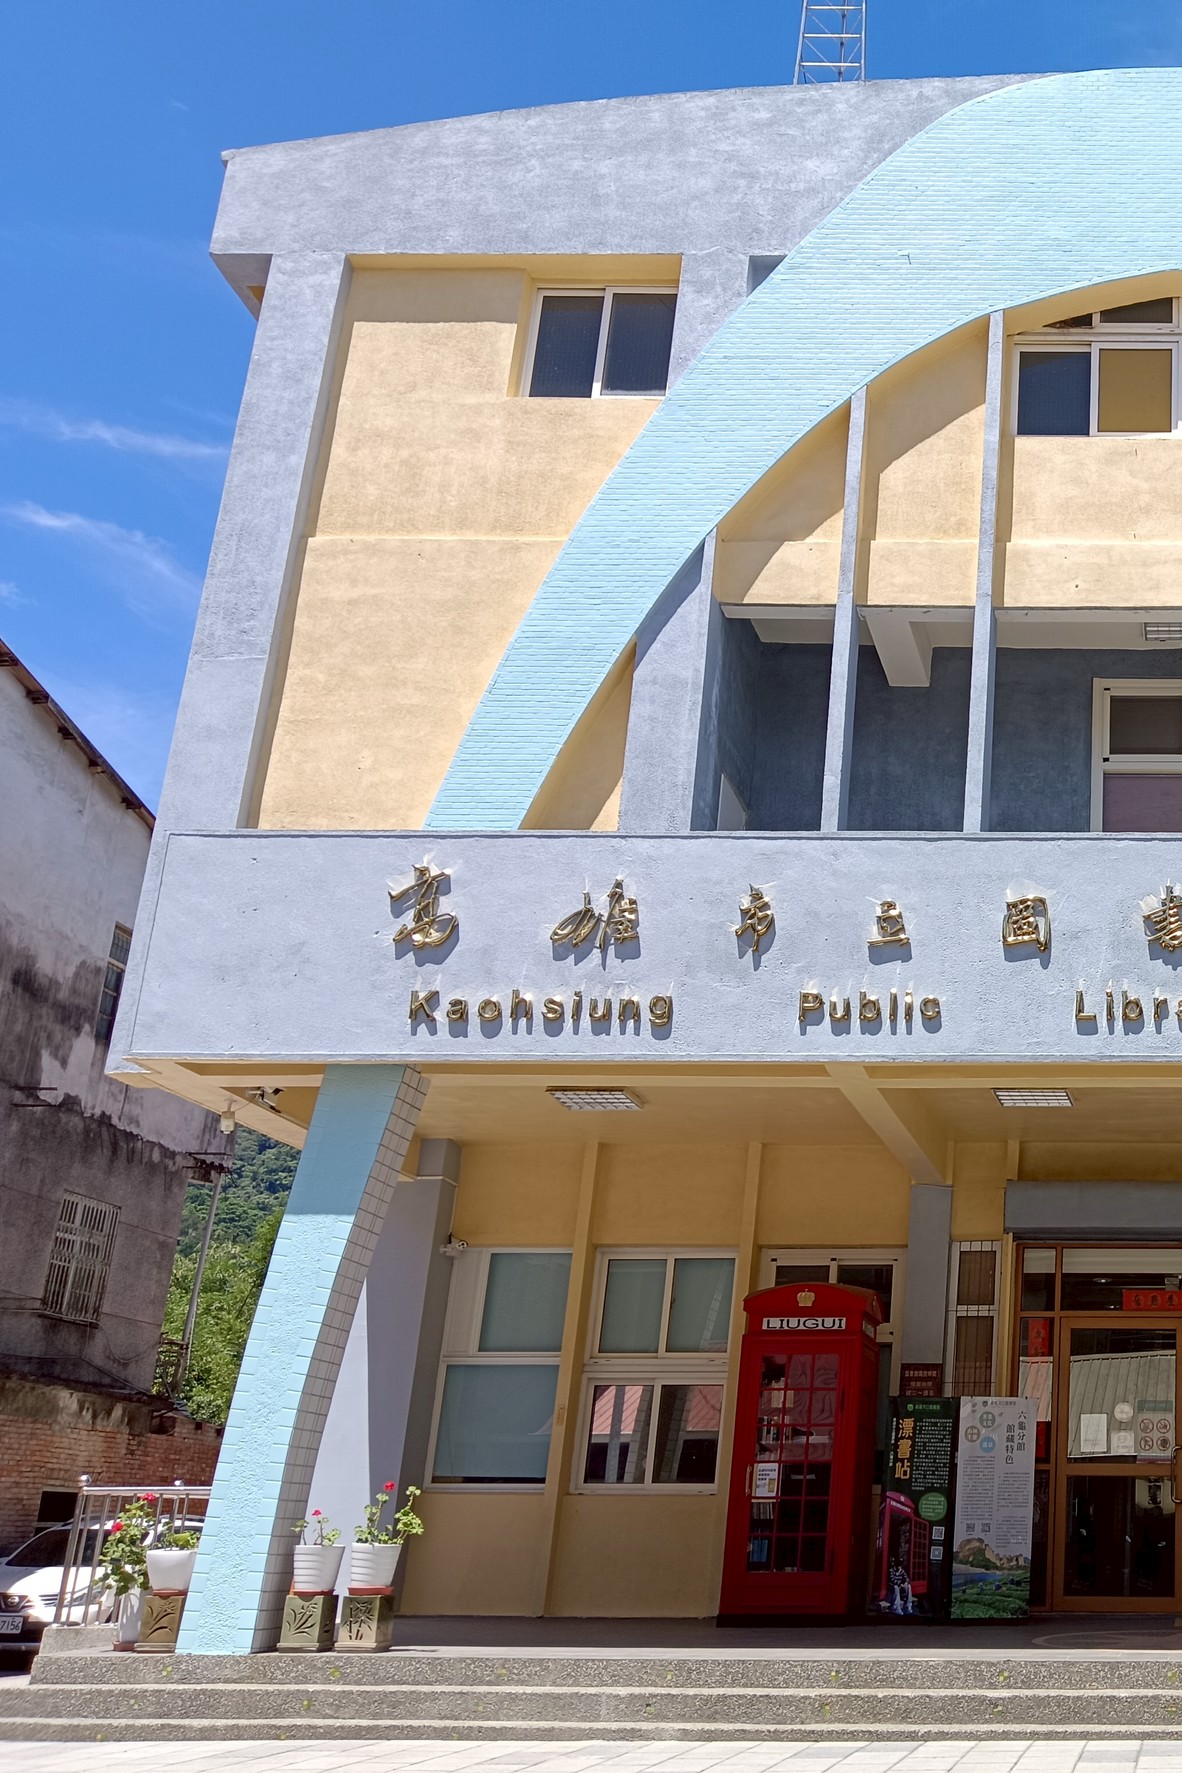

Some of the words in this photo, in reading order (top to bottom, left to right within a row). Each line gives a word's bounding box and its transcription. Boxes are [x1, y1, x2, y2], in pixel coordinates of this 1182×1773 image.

[408, 987, 674, 1027] Kaohsiung
[799, 988, 942, 1022] Public
[766, 1318, 844, 1329] LIUGUI
[895, 1418, 915, 1479] 漂書站
[1005, 1424, 1015, 1465] 館藏特色
[1017, 1411, 1027, 1451] 六龜分館
[0, 1620, 21, 1631] 7156
